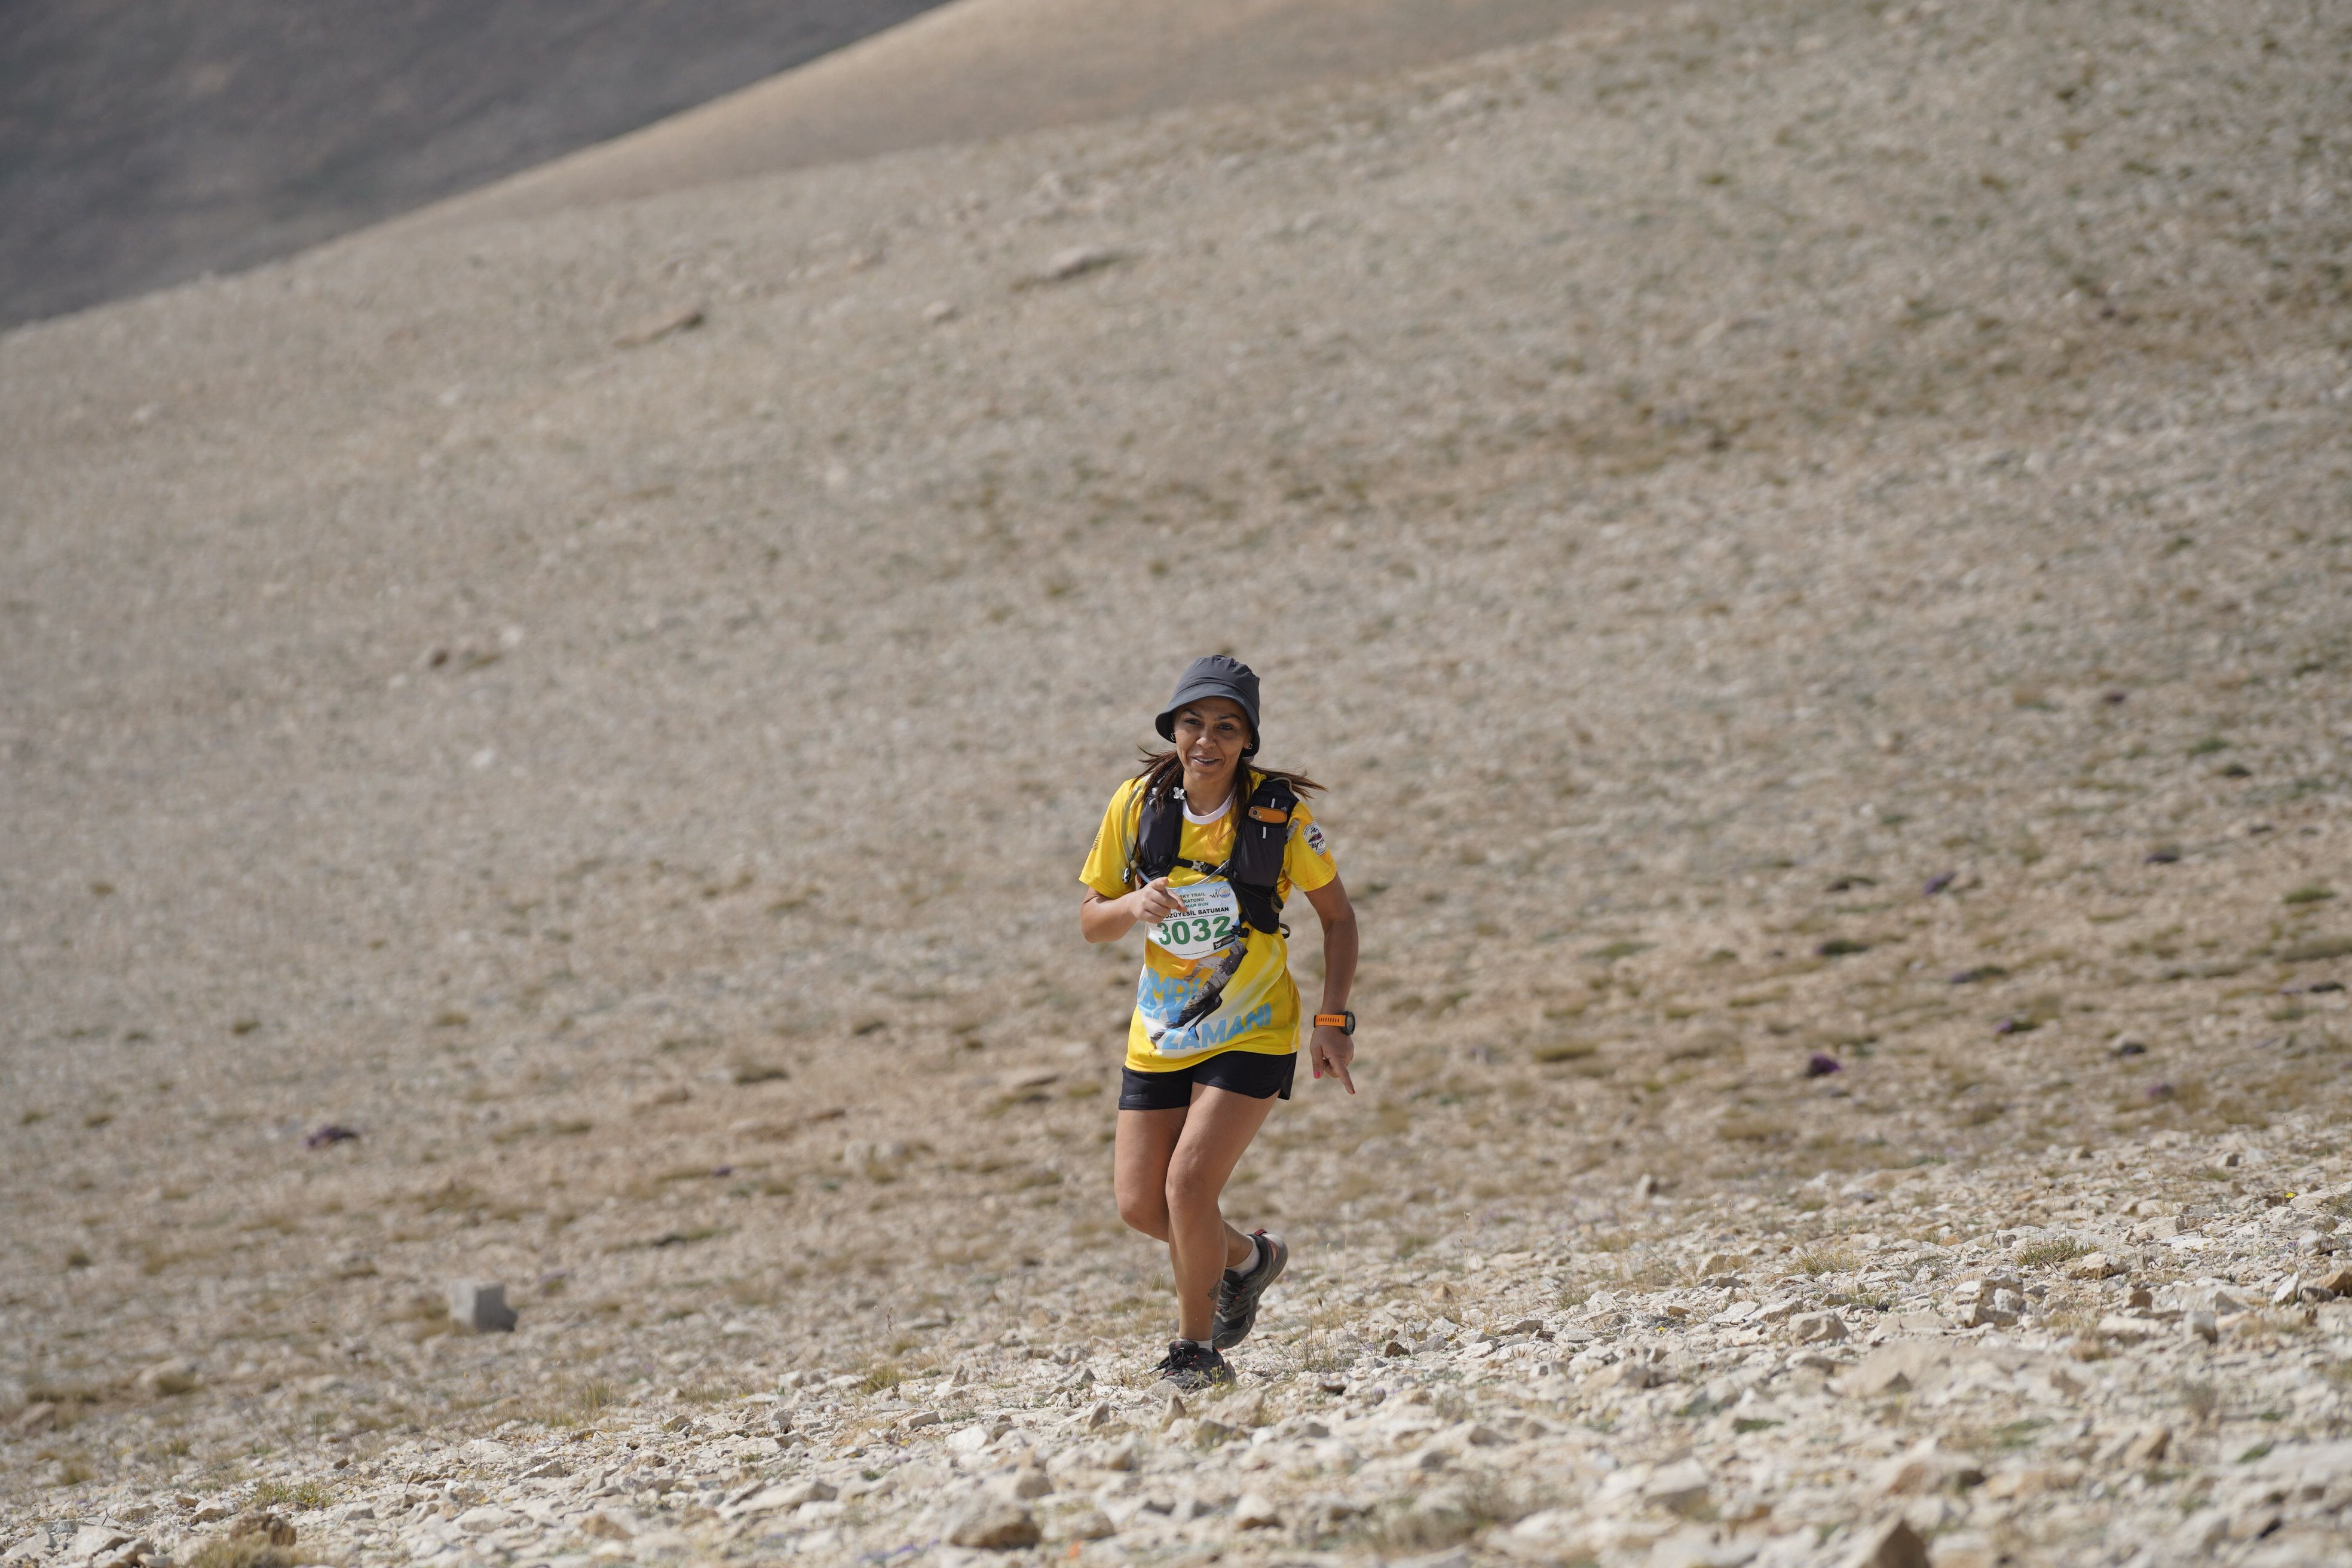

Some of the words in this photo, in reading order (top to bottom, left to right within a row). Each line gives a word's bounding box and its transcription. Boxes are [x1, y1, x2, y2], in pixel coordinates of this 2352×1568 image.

[1198, 906, 1229, 914] BATUMAN
[1157, 915, 1231, 945] 3032
[1162, 1002, 1272, 1049] ZAMANI
